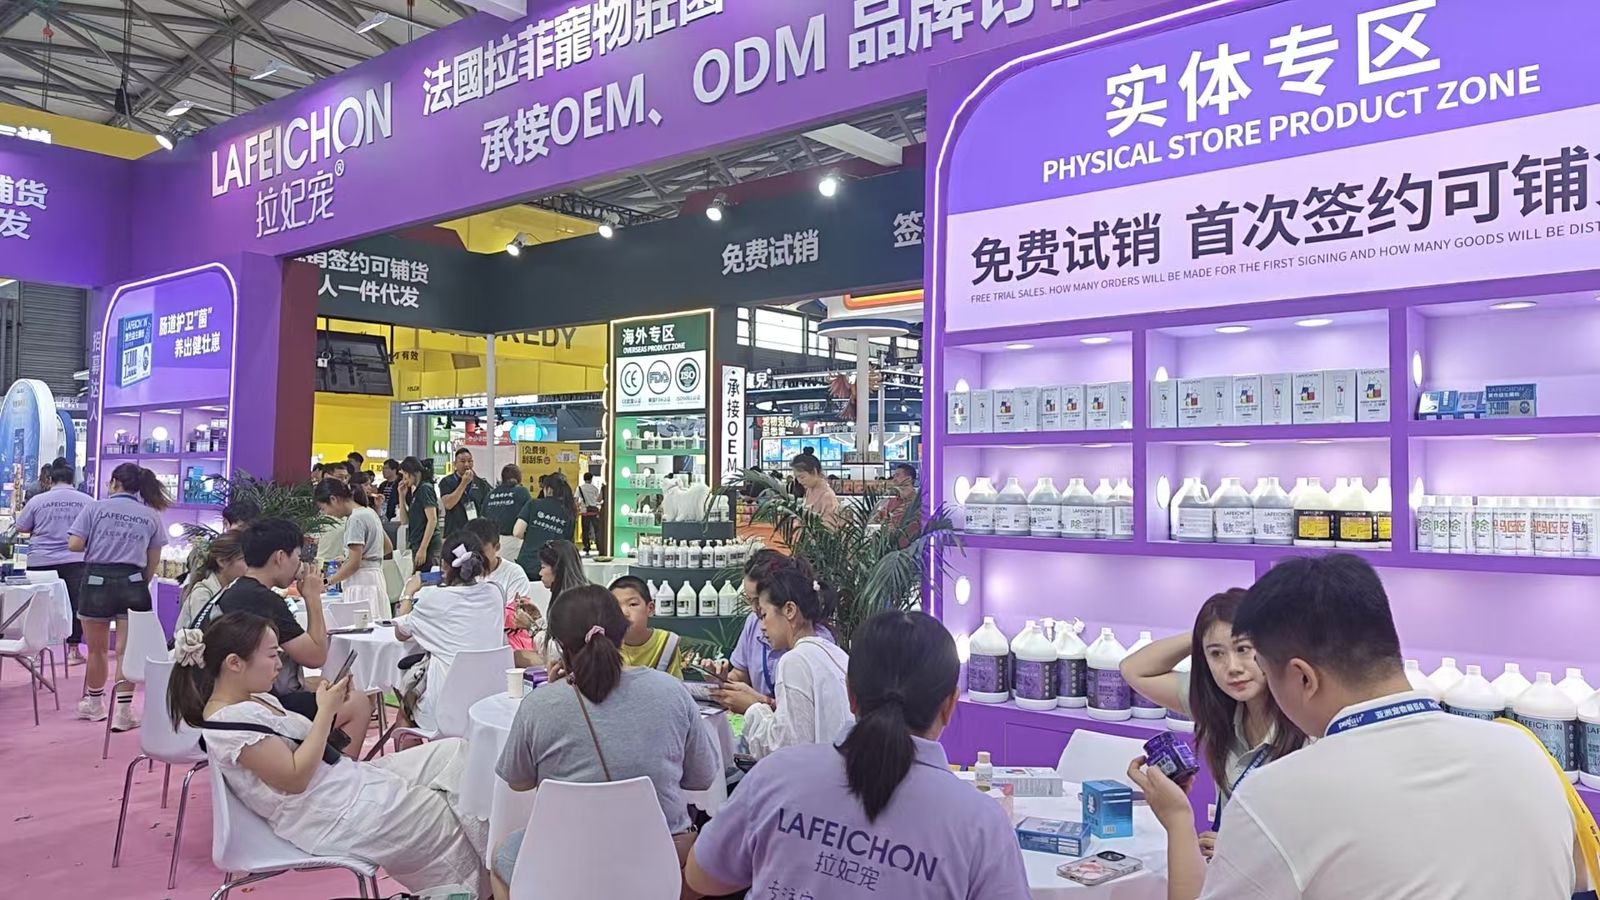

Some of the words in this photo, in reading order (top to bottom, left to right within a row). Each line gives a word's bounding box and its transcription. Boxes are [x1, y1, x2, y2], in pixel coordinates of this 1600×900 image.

[693, 14, 826, 104] ODM
[1106, 0, 1441, 138] 实体专区
[212, 81, 392, 198] LAFEICHON
[1043, 141, 1162, 183] PHYSICAL
[1168, 119, 1261, 160] STORE
[1269, 86, 1429, 142] PRODUCT
[1436, 64, 1540, 110] ZONE
[256, 169, 334, 238] 拉妃宠
[971, 212, 1162, 286] 免费试销
[1185, 144, 1600, 260] 首次签约可铺
[721, 229, 819, 277] 免费试销
[893, 210, 924, 248] 签
[971, 294, 991, 304] FREE
[993, 290, 1016, 302] TRIAL
[1018, 287, 1048, 299] SALES.
[1049, 284, 1071, 295] HOW
[1073, 281, 1099, 292] MANY
[1100, 276, 1140, 289] ORDERS
[1141, 272, 1165, 284] WILL
[1168, 270, 1181, 282] BE
[1183, 267, 1212, 280] MADE
[1215, 264, 1236, 276] FOR
[1240, 261, 1261, 273] THE
[1263, 257, 1295, 271] FIRST
[1298, 251, 1347, 267] SIGNING
[1350, 248, 1376, 261] AND
[1379, 243, 1411, 257] HOW
[1414, 238, 1451, 253] MANY
[1454, 233, 1504, 248] GOODS
[1508, 229, 1542, 242] WILL
[1546, 225, 1565, 238] BE
[318, 274, 419, 308] 人一件代发
[622, 324, 675, 346] 海外专区
[623, 346, 647, 354] OVERSEAS
[648, 344, 671, 352] PRODUCT
[671, 342, 686, 350] ZONE
[649, 371, 670, 384] FDA
[680, 371, 696, 380] ISO
[100, 511, 149, 525] LAFEICHON
[777, 807, 938, 882] LAFEICHON
[814, 850, 880, 892] 拉妃宠
